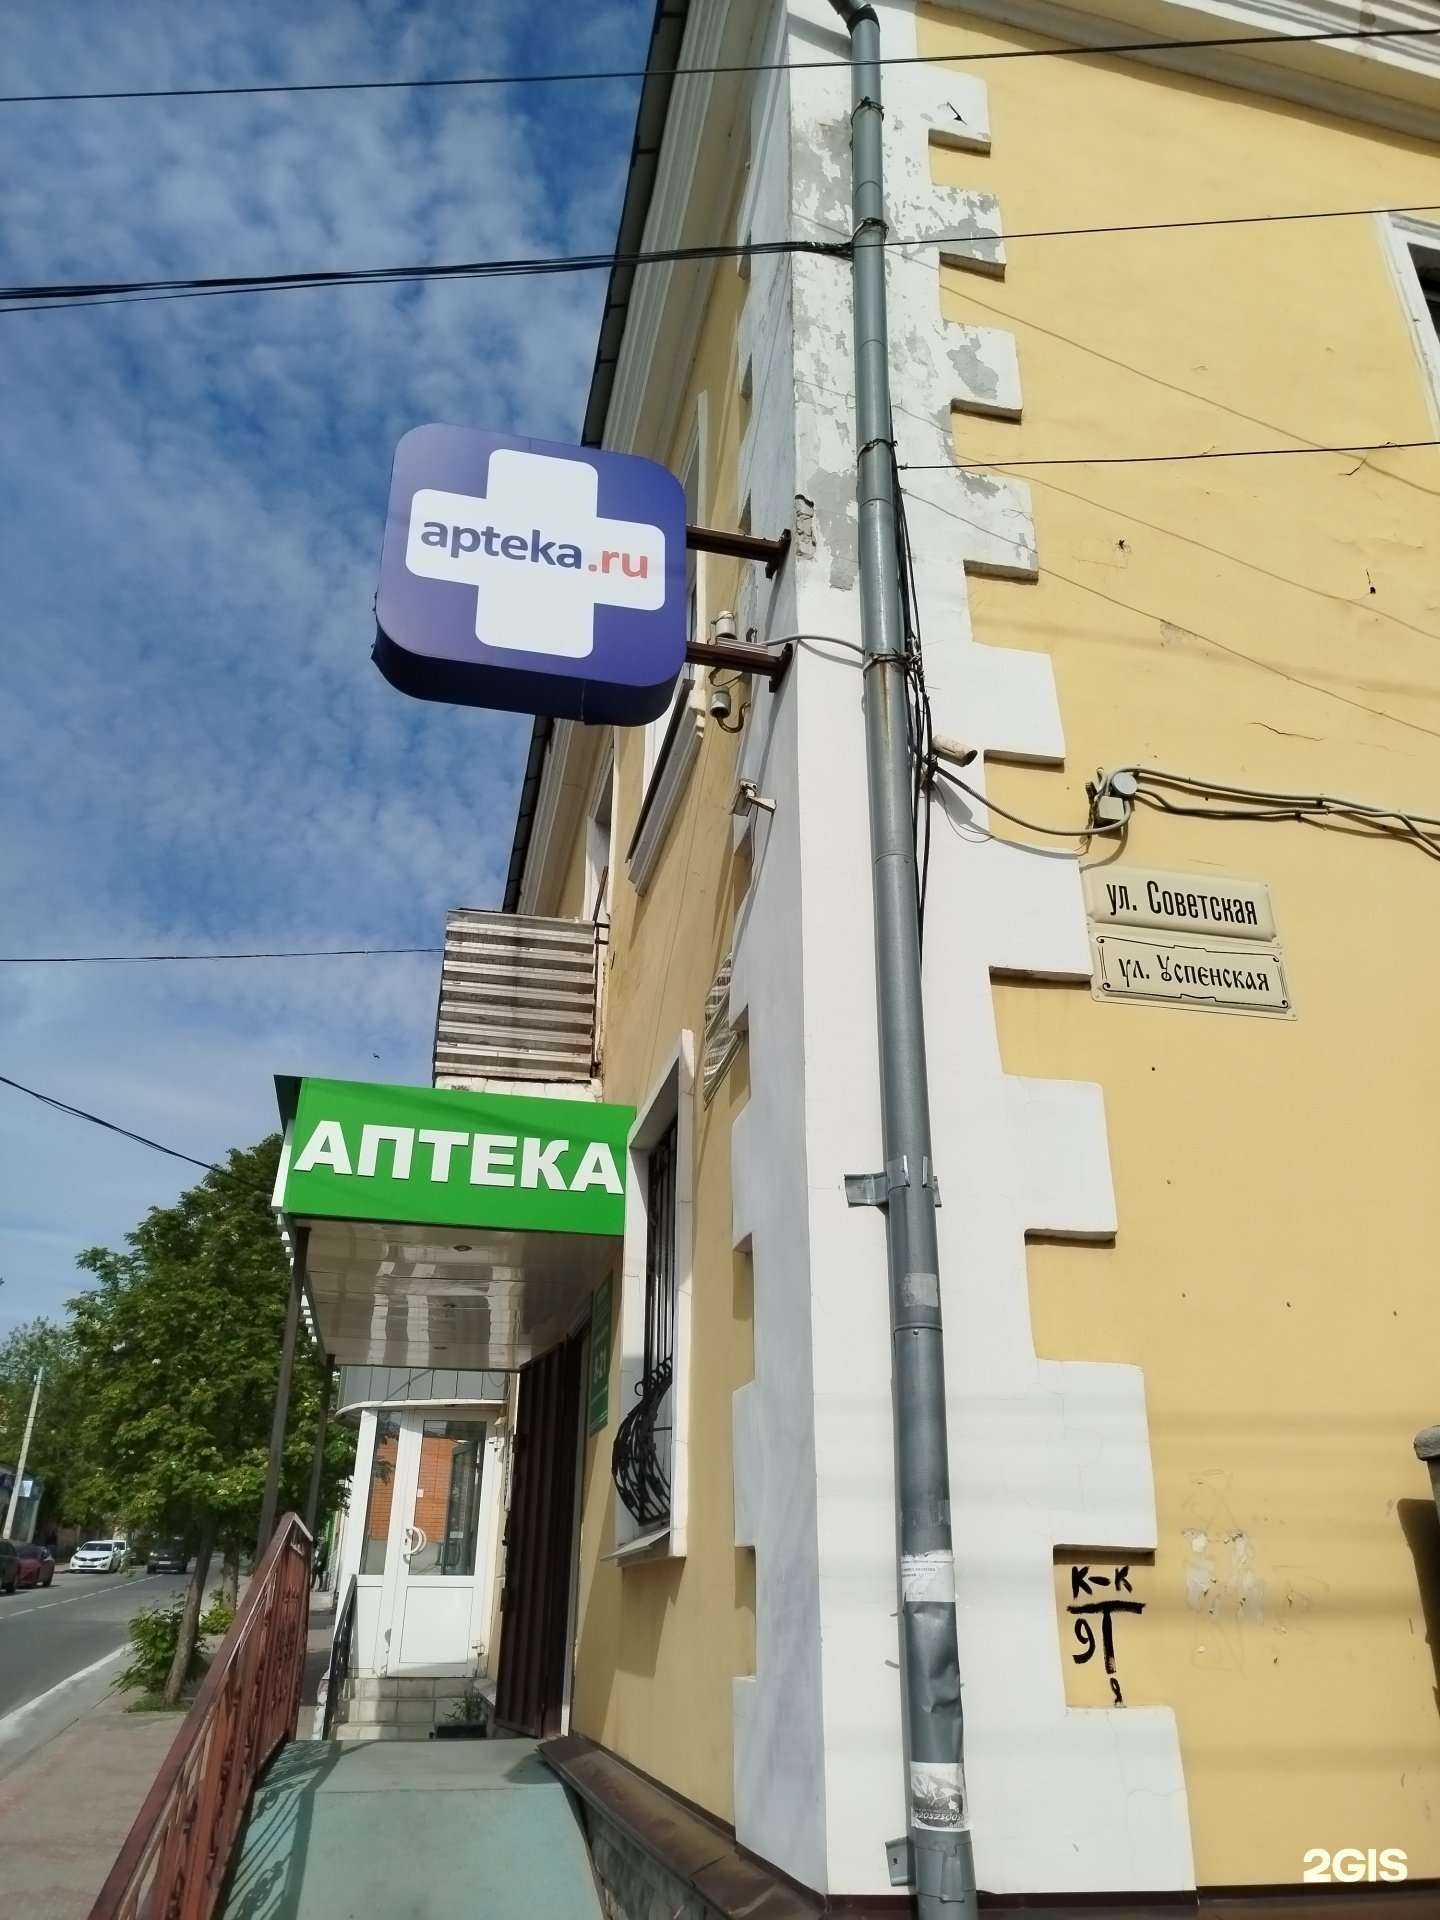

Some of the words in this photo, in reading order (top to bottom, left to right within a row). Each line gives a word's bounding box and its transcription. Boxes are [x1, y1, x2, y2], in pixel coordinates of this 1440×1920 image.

[421, 521, 648, 578] apteka.ru
[1106, 883, 1137, 915] ул.
[1146, 880, 1258, 925] Советская
[1118, 957, 1150, 987] ул.
[1157, 954, 1269, 991] Успенская
[293, 1120, 624, 1195] АПТЕКА
